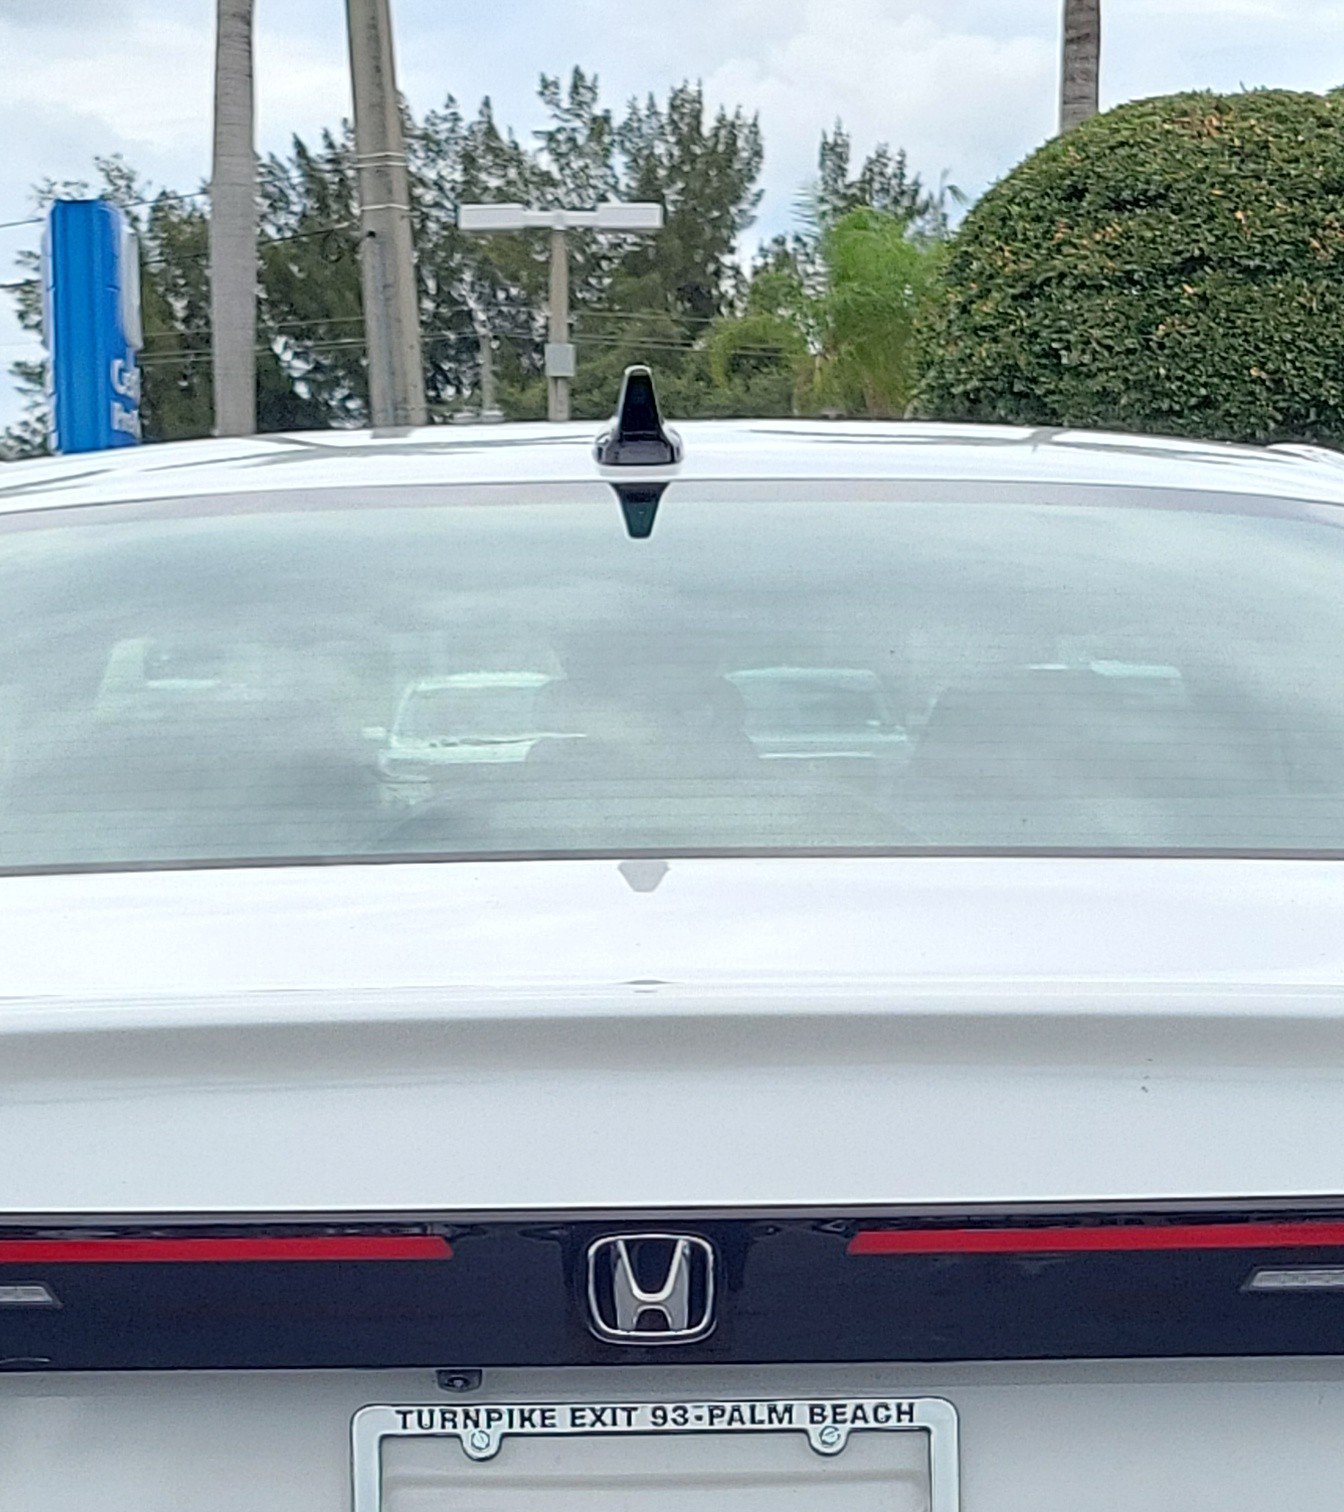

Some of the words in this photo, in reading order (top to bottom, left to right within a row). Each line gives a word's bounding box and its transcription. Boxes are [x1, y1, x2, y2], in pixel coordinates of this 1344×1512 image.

[395, 1408, 557, 1430] TURNPIKE
[570, 1406, 638, 1428] EXIT
[808, 1402, 915, 1425] BEACH
